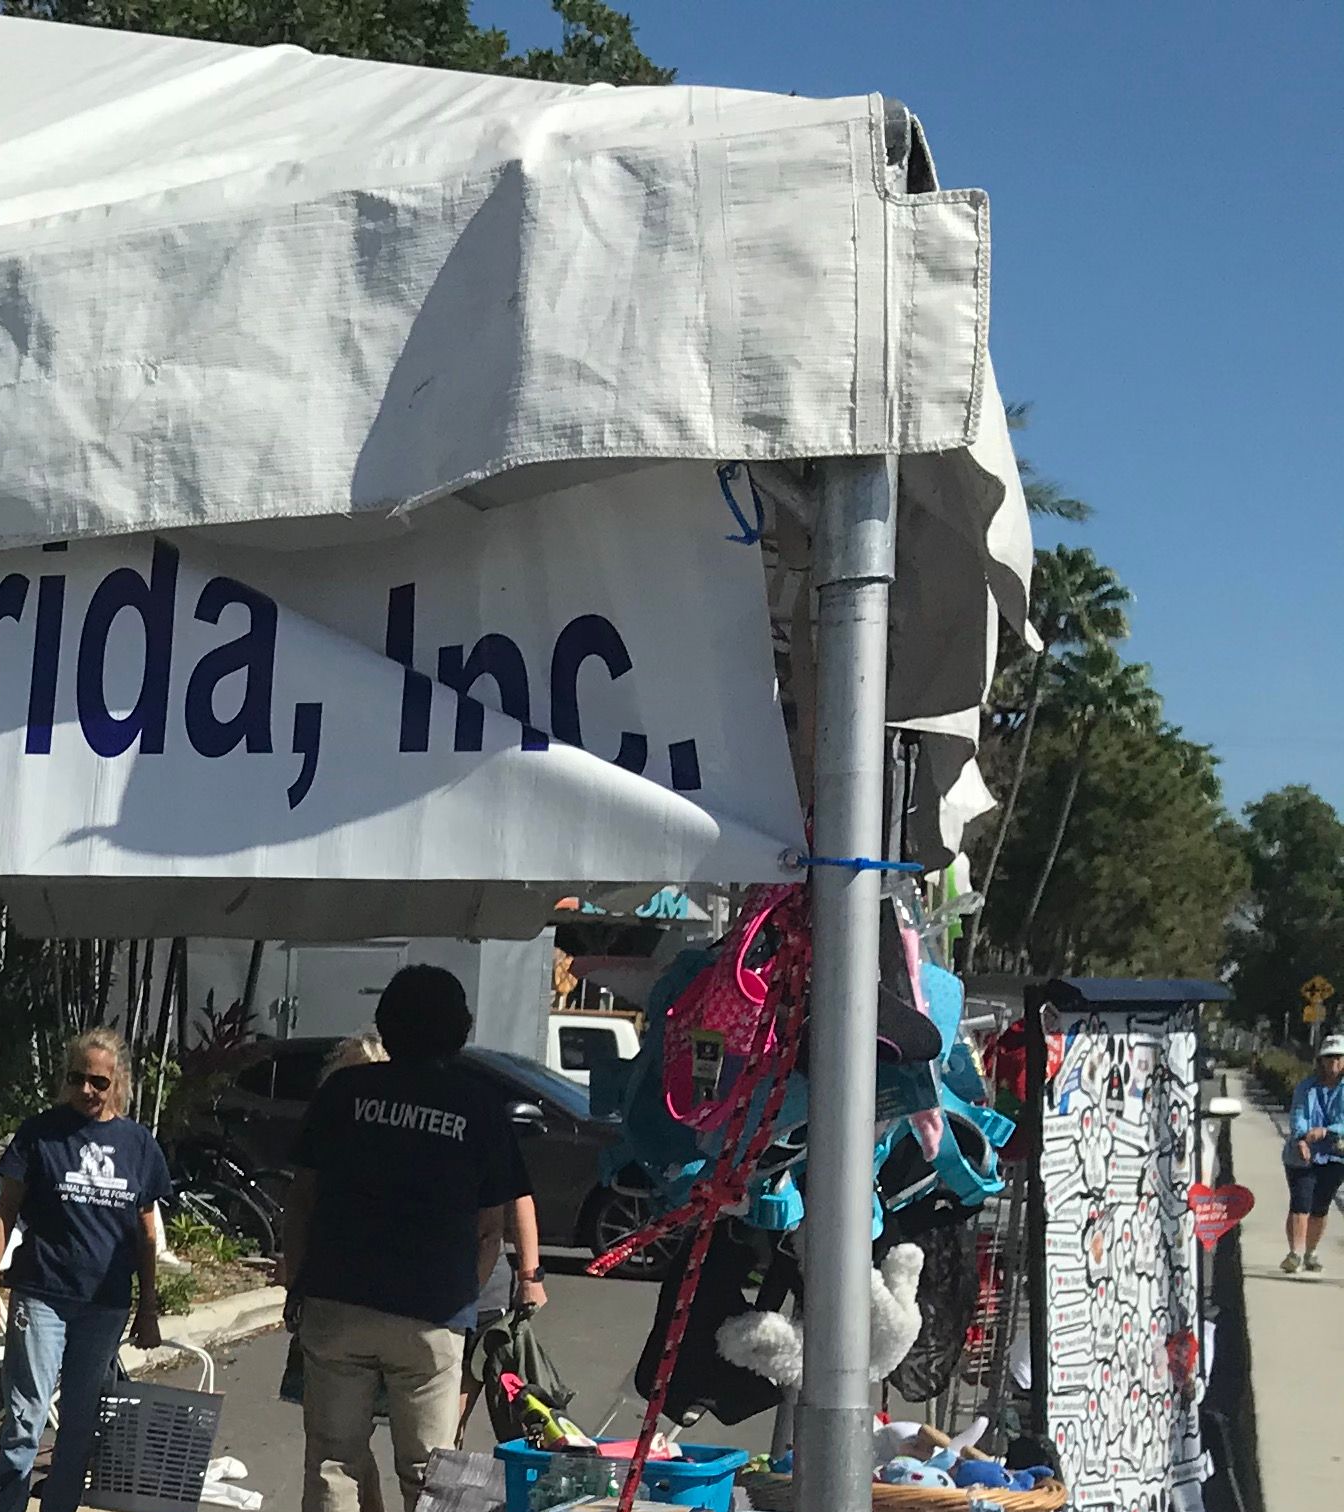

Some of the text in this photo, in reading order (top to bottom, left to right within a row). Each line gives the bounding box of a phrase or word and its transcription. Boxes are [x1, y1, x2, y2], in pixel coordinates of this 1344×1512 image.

[386, 583, 702, 792] Inc.
[353, 1096, 468, 1142] VOLUNTEER
[70, 1193, 87, 1203] South
[111, 1189, 136, 1202] FORCE
